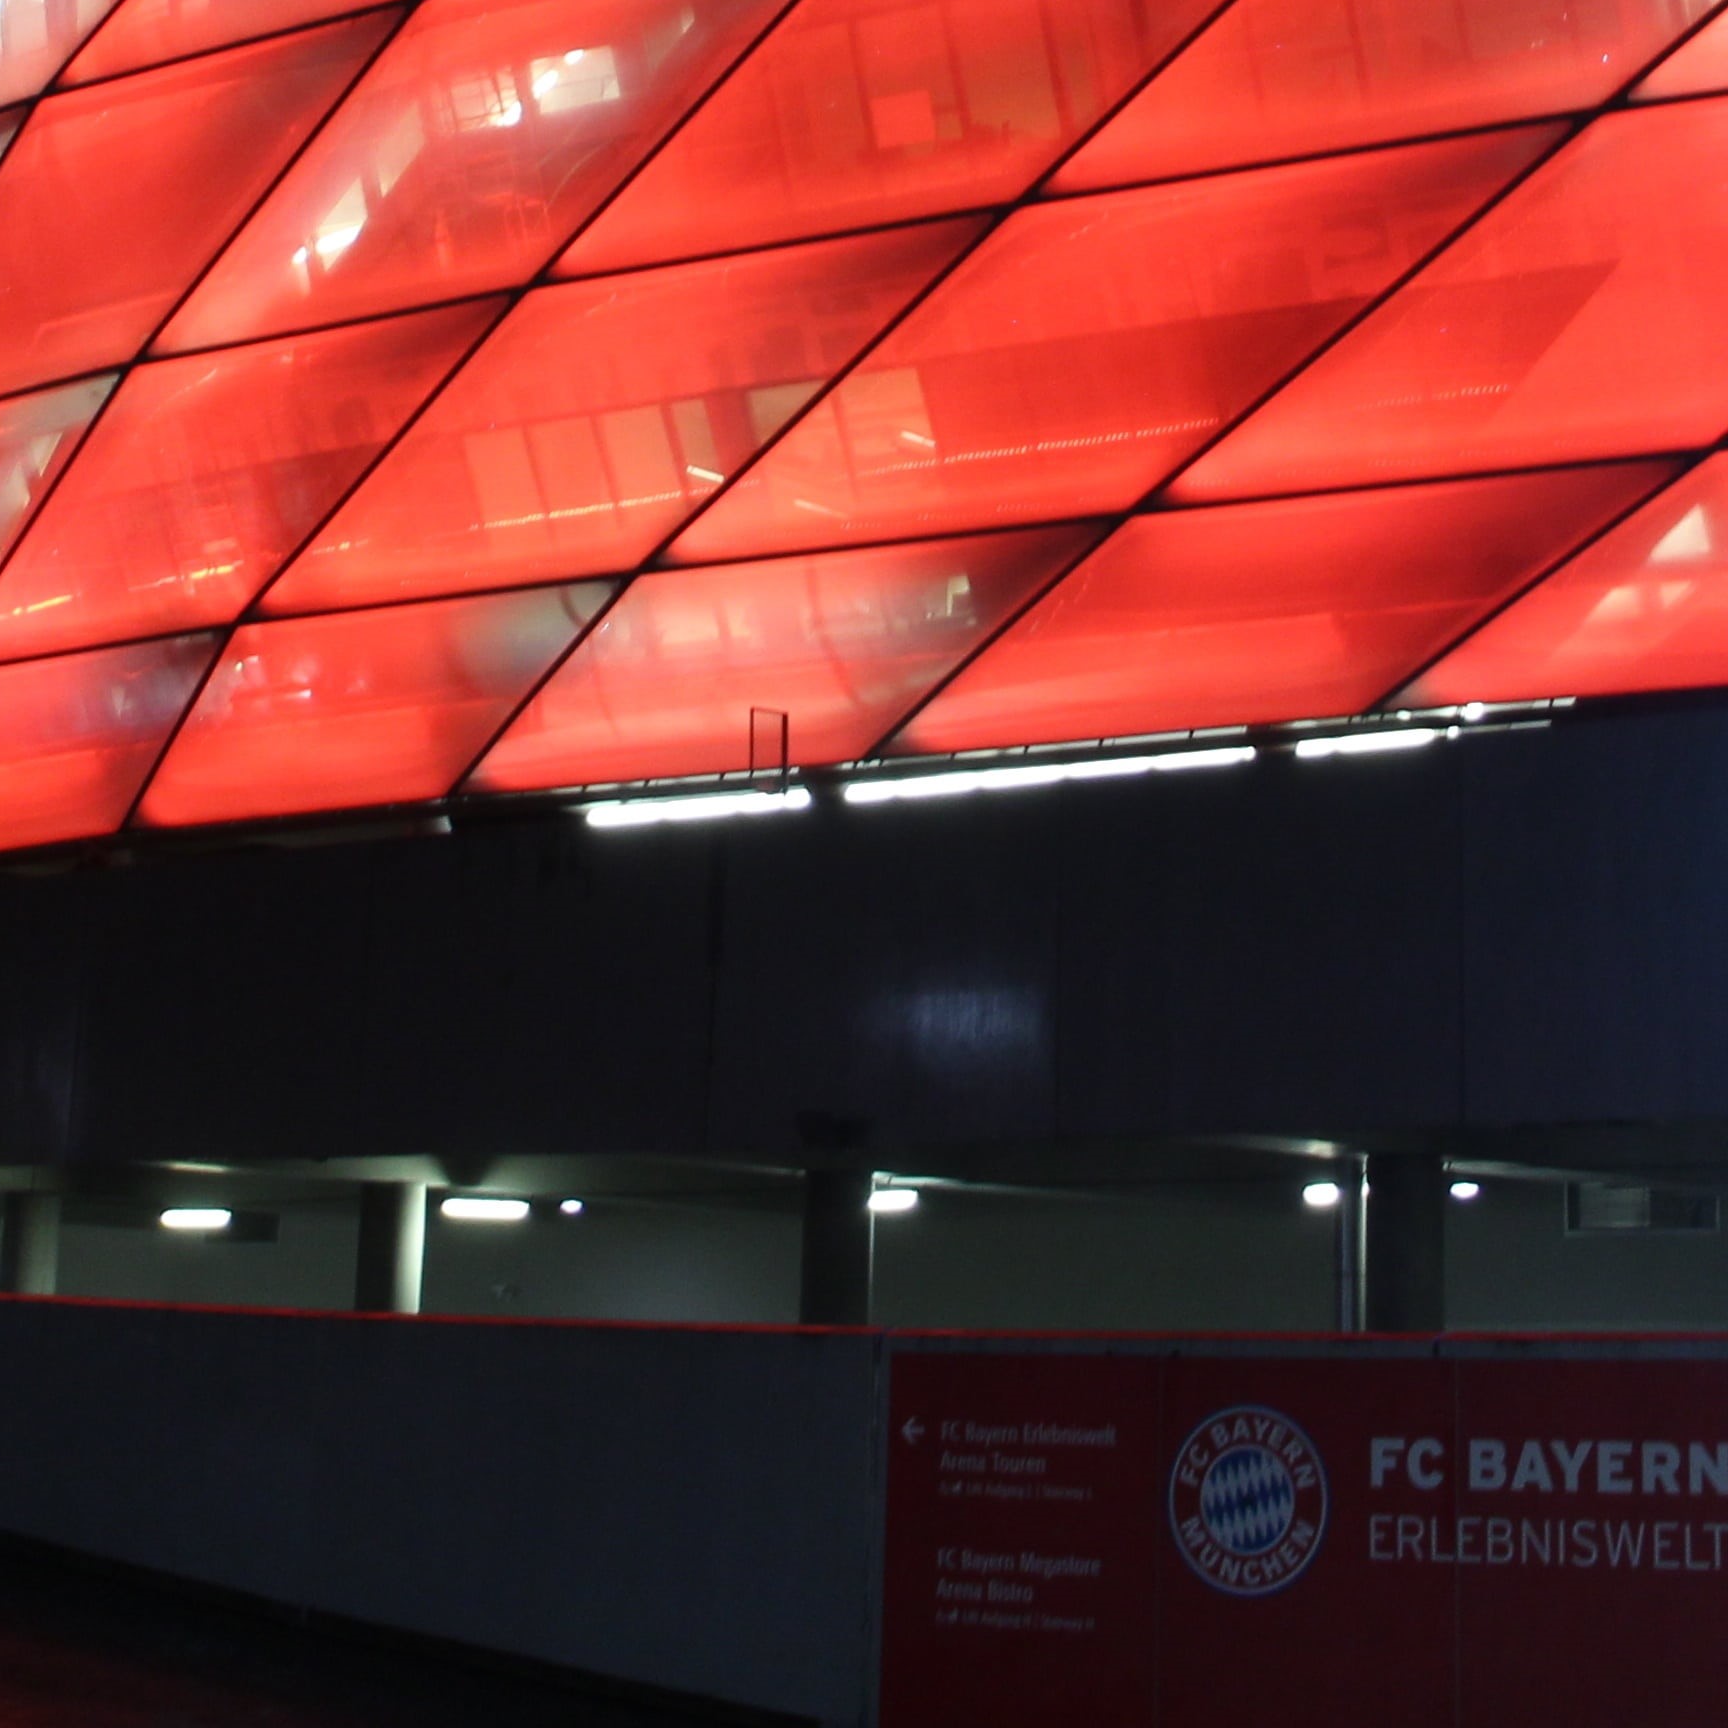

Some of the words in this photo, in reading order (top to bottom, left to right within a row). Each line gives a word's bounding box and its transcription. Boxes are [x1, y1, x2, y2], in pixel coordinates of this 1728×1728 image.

[941, 1420, 961, 1441] FC
[965, 1419, 1018, 1448] Bayern
[939, 1450, 986, 1473] Arena
[1180, 1442, 1212, 1487] FC
[1208, 1416, 1318, 1491] BAYERN
[1369, 1436, 1445, 1492] FC
[938, 1546, 957, 1570] FC
[961, 1546, 1015, 1574] Bayern
[1020, 1551, 1101, 1579] Megastore
[1179, 1515, 1318, 1587] MÜNCHEN
[936, 1577, 983, 1601] Arena
[987, 1579, 1034, 1603] Bistro
